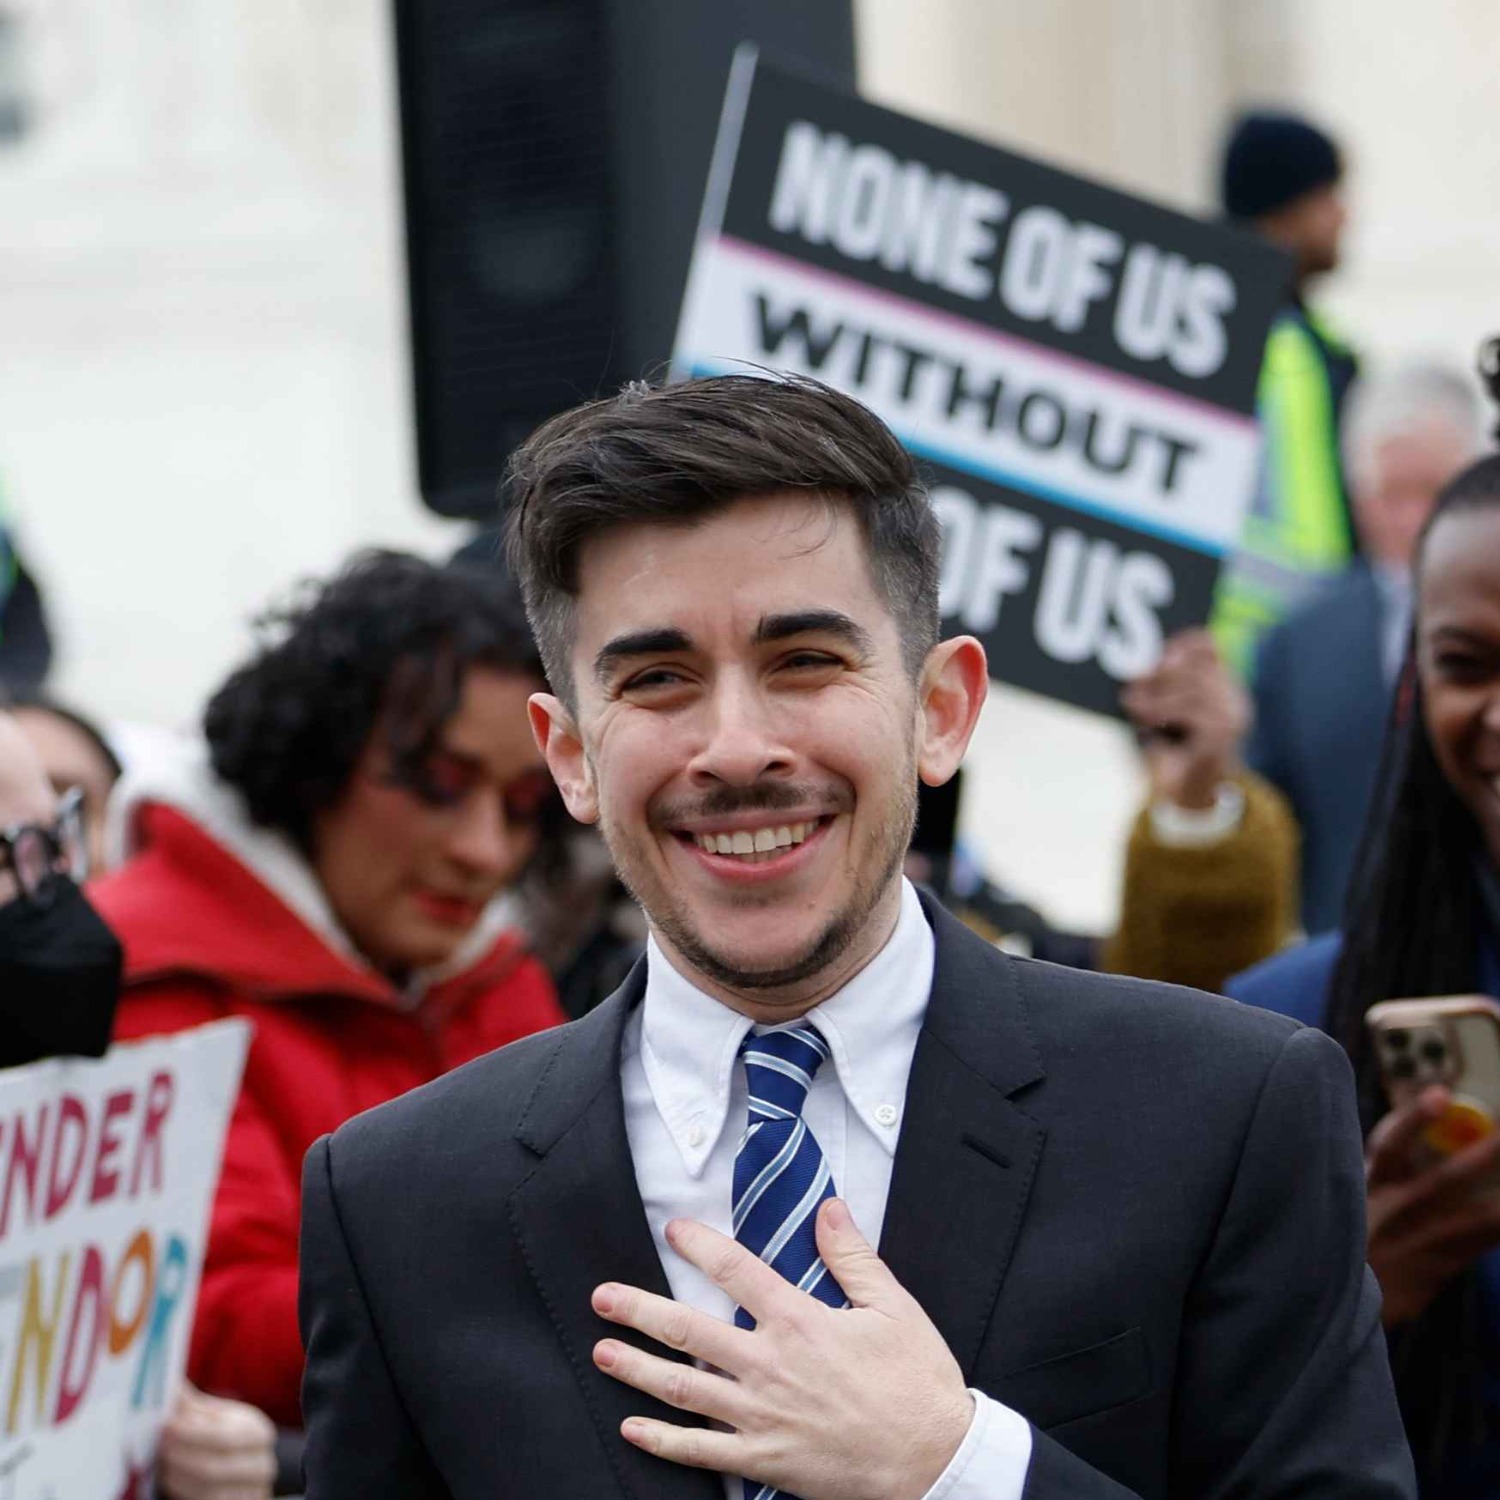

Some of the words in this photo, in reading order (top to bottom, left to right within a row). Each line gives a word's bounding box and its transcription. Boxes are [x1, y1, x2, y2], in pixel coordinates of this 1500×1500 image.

[767, 119, 1010, 301] NONE
[1001, 205, 1124, 333] OF
[1112, 243, 1236, 379] US
[753, 291, 1200, 494] WITHOUT
[930, 484, 1043, 632] OF
[1033, 526, 1175, 681] US
[0, 1070, 175, 1240] NDER
[0, 1228, 187, 1435] NDOR
